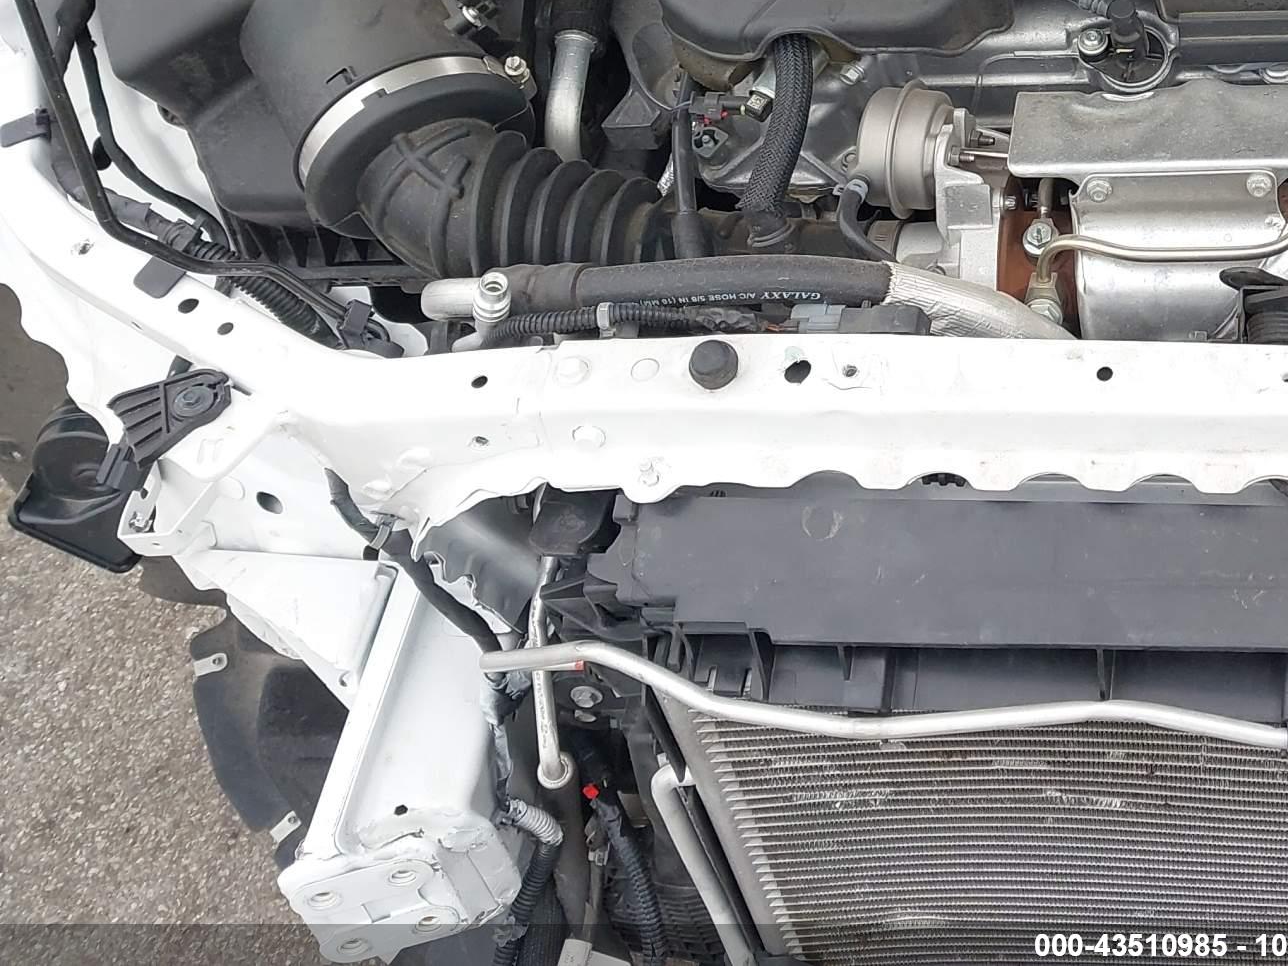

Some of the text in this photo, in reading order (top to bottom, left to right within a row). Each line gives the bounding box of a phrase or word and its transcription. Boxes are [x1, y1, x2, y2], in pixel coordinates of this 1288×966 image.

[691, 295, 706, 303] 5/8
[707, 293, 737, 301] HOSE
[739, 292, 756, 300] A/C
[761, 291, 822, 301] GALAXY
[678, 296, 690, 305] IN
